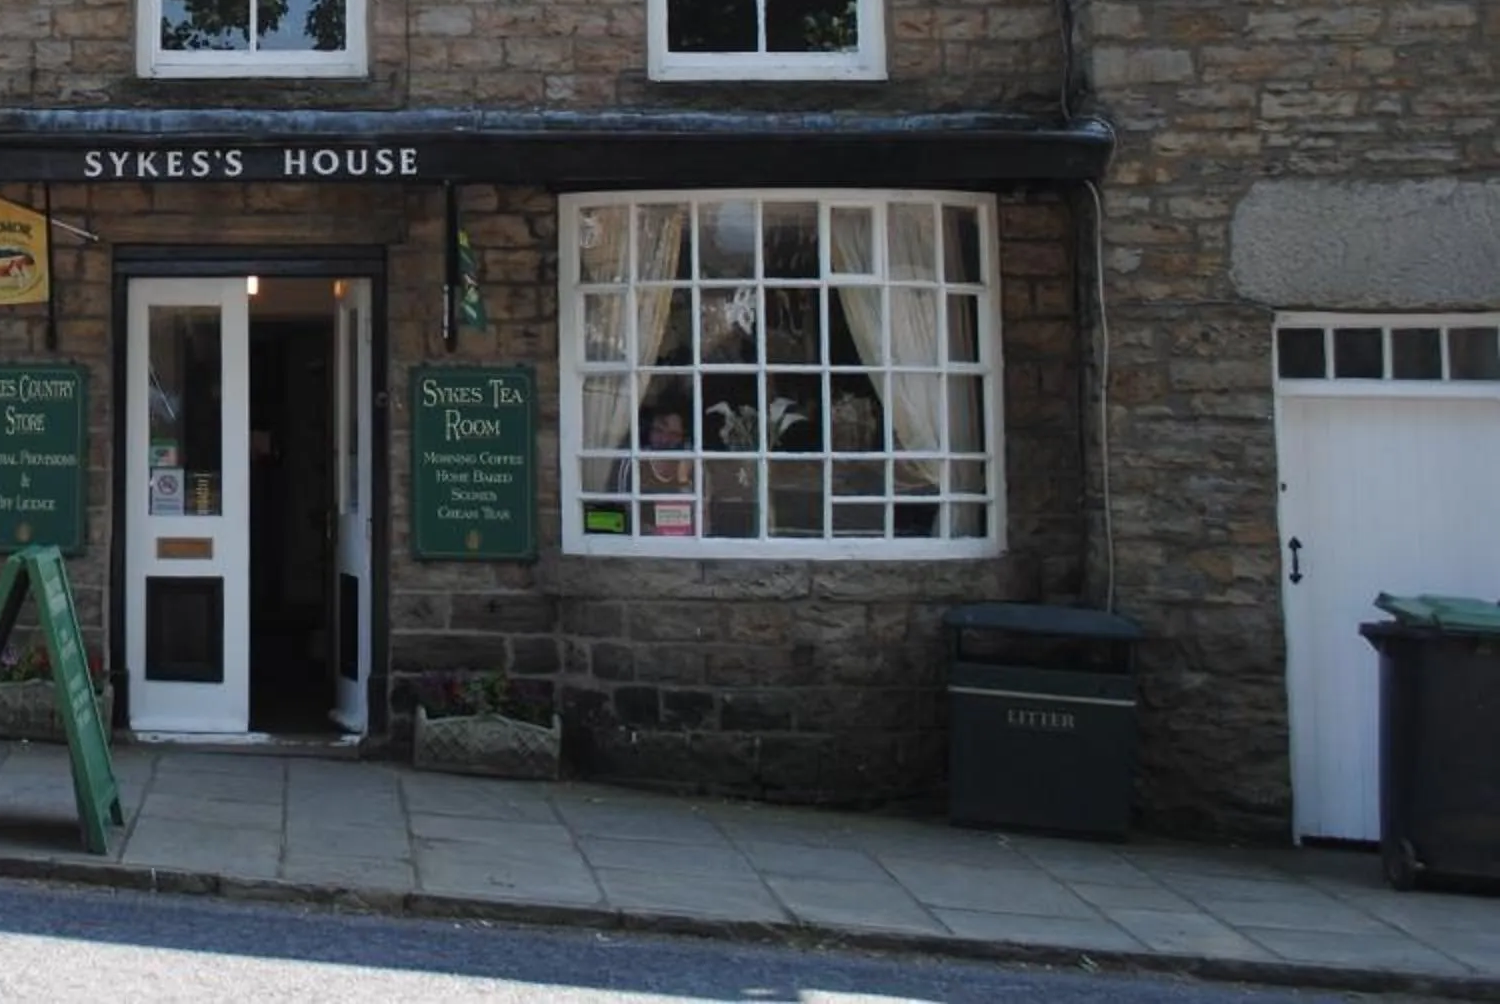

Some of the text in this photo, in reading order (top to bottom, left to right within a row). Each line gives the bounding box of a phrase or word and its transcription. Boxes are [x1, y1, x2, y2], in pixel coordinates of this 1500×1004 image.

[84, 147, 418, 178] SYKES'S HOUSE
[19, 374, 76, 403] COUNTRY
[422, 379, 524, 409] SYKES TEA
[4, 405, 46, 435] STORE
[445, 409, 501, 441] ROOM
[479, 451, 525, 466] COFFEE
[1007, 708, 1075, 728] LITTER
